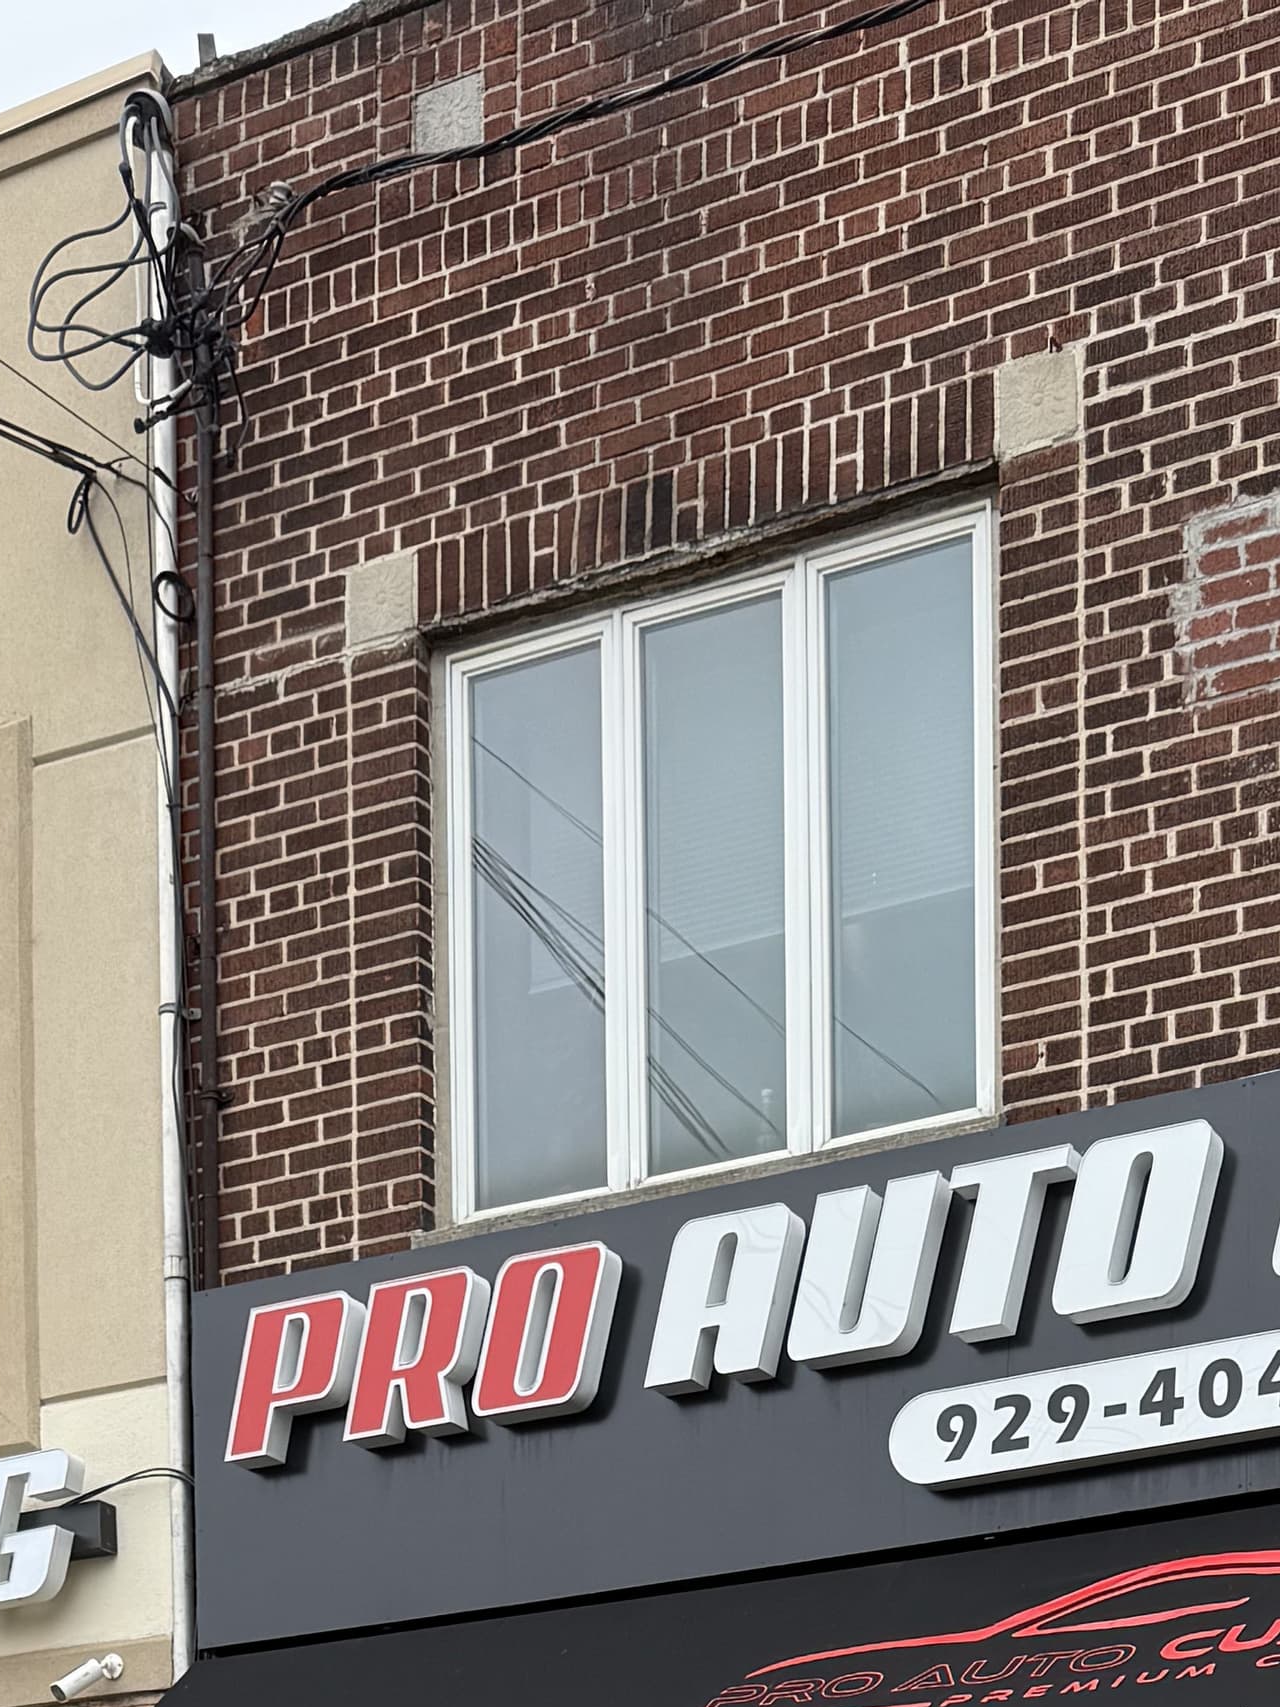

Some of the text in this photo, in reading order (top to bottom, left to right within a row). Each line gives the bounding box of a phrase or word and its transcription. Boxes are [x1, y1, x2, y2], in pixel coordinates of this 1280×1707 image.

[223, 1240, 622, 1469] PRO
[643, 1117, 1225, 1395] AUTO
[891, 1642, 1138, 1695] AUTO
